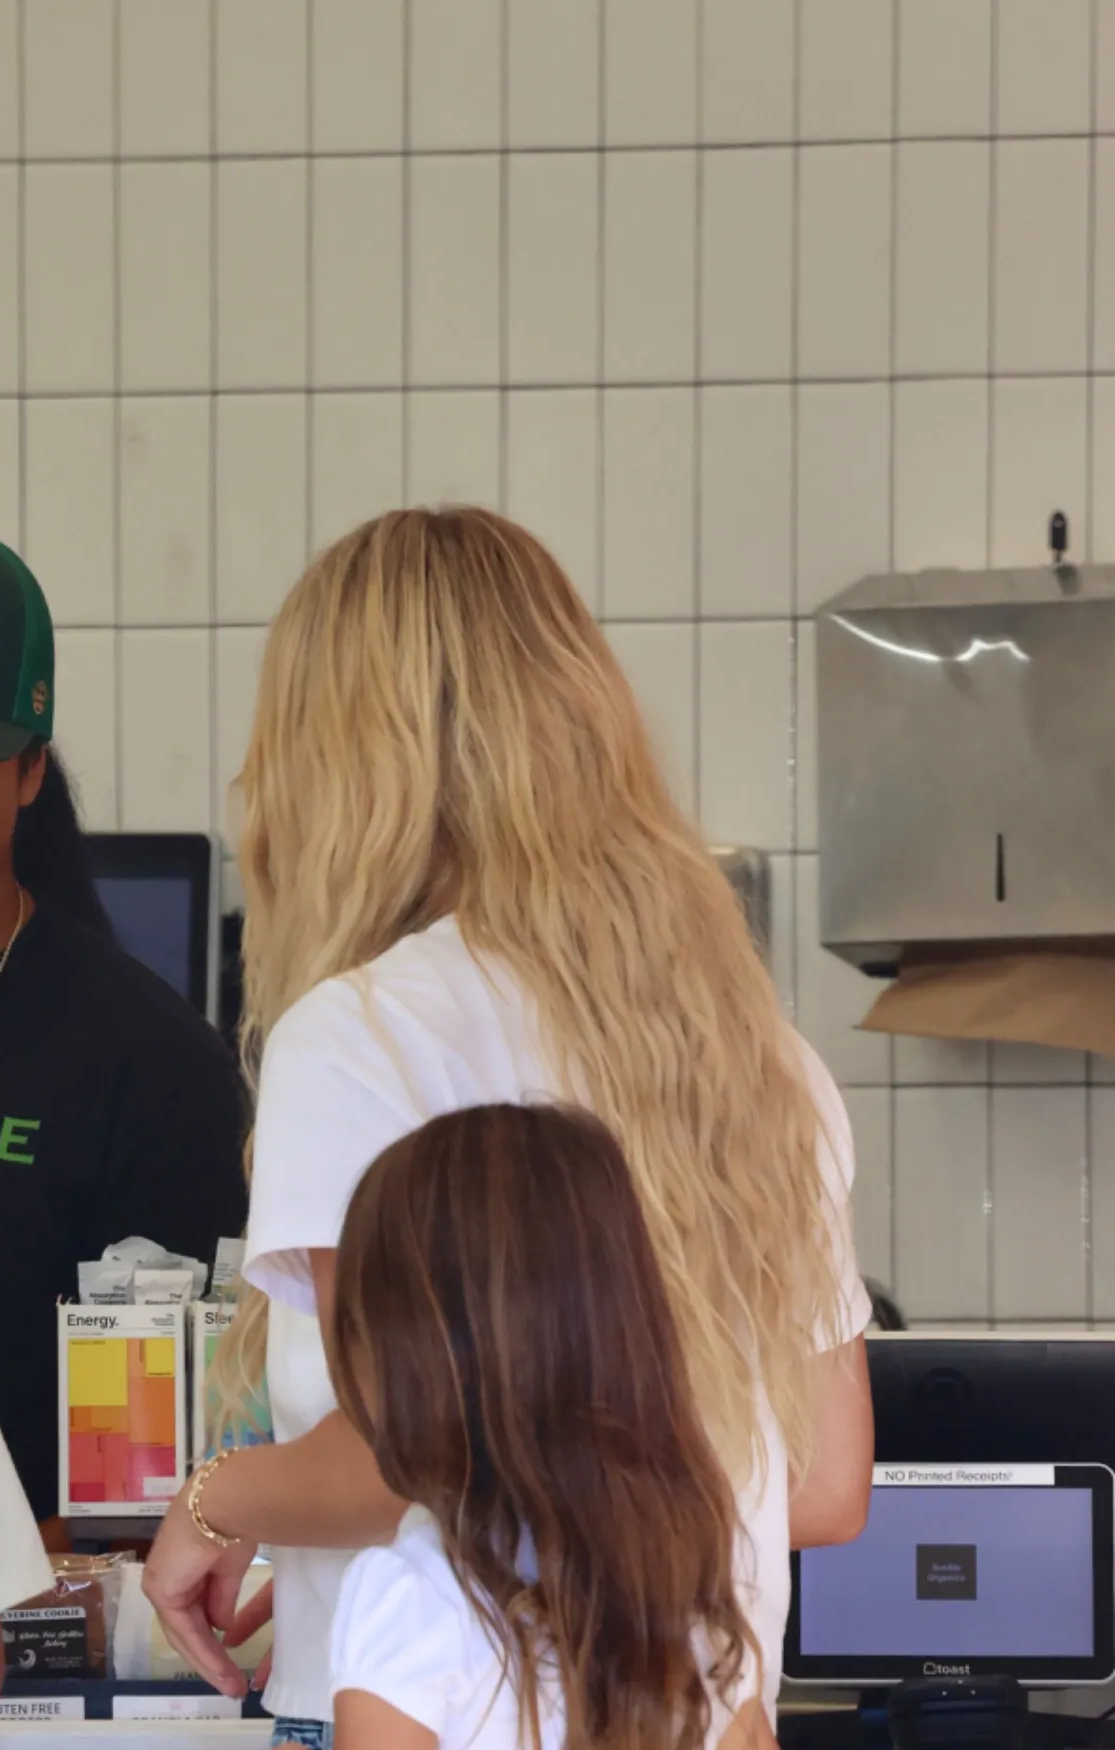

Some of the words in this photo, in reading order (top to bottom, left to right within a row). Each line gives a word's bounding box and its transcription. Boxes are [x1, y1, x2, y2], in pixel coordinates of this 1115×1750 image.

[885, 1470, 905, 1481] NO
[908, 1470, 953, 1481] Printed
[31, 1703, 61, 1715] FREE
